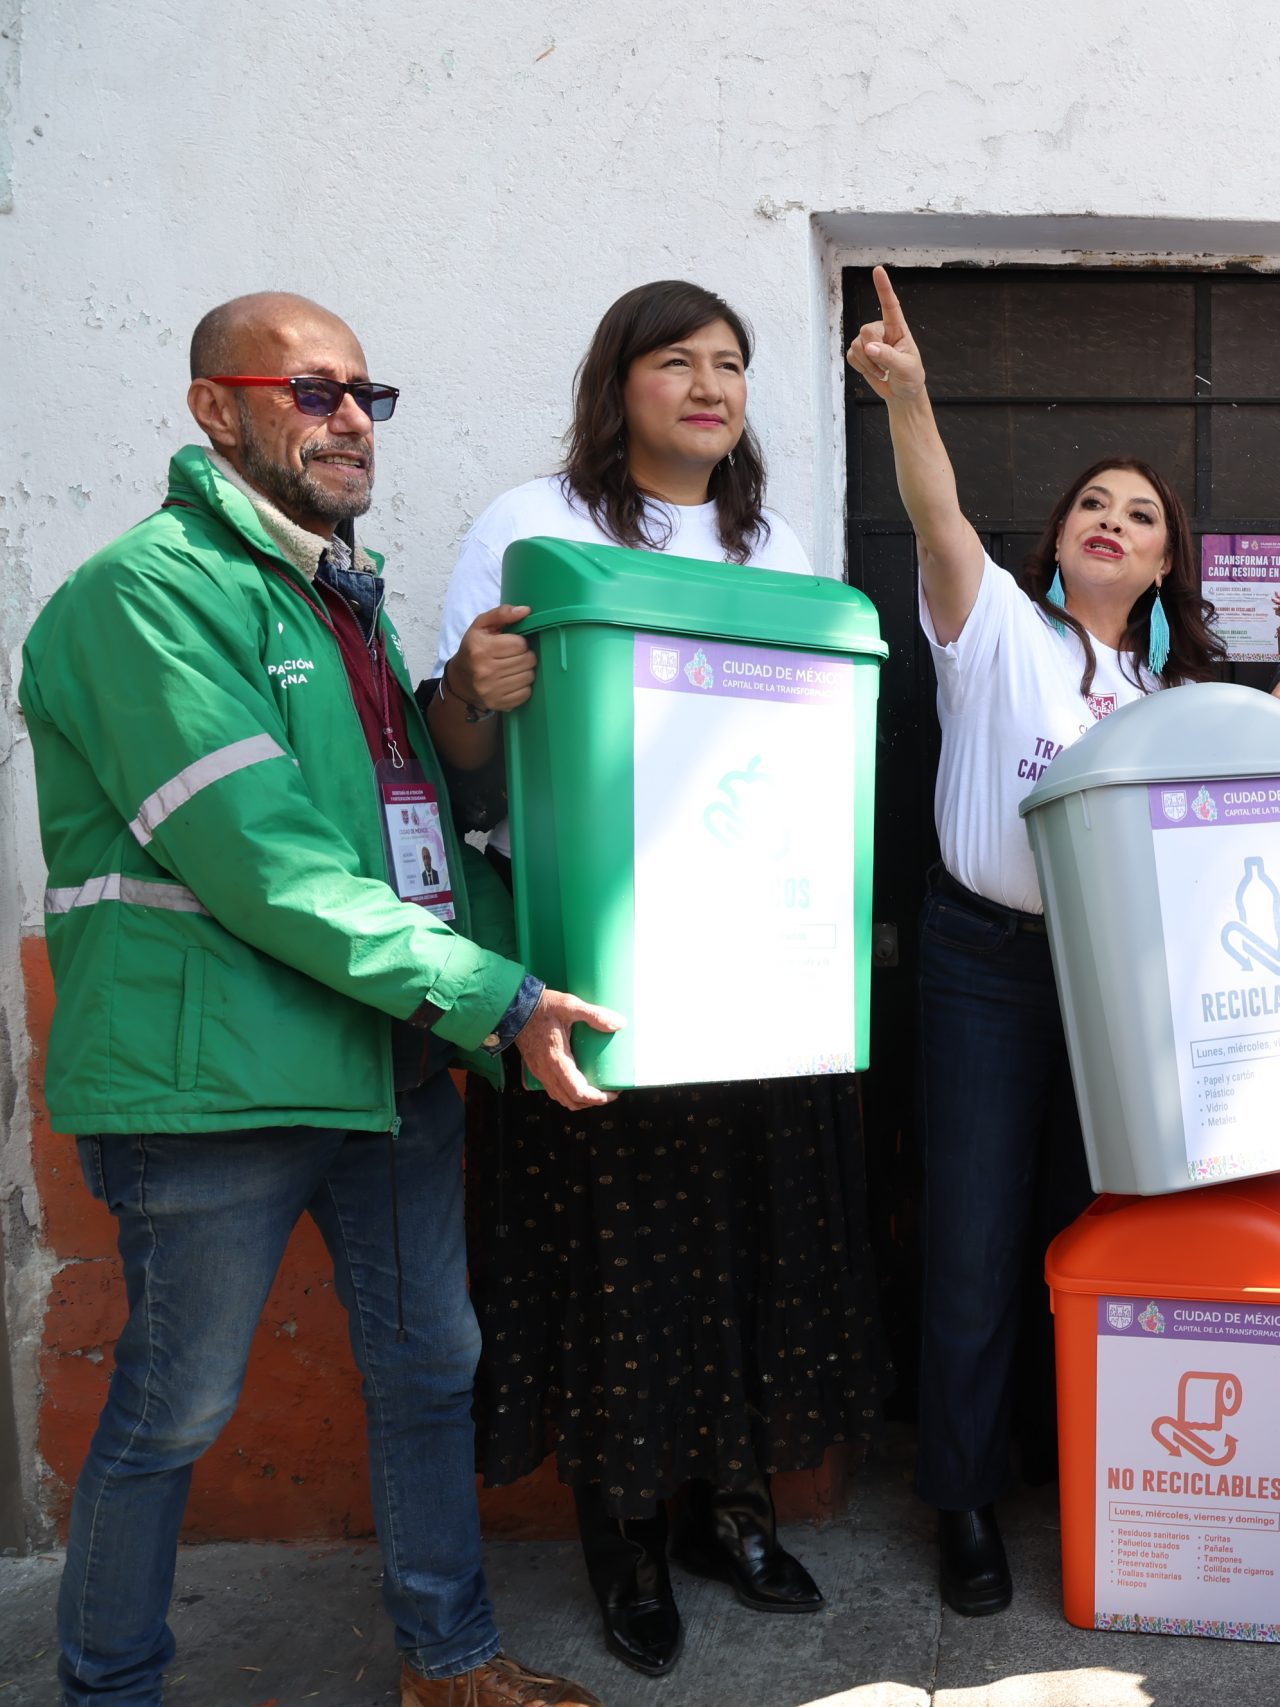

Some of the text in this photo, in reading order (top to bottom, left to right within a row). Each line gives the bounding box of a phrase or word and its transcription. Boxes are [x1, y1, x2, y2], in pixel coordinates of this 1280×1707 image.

[1214, 555, 1268, 566] TRANSFORMA
[1271, 556, 1280, 566] TU
[1209, 567, 1229, 577] CADA
[1232, 567, 1267, 577] RESIDUO
[1269, 568, 1279, 577] EN
[723, 660, 773, 678] CIUDAD
[776, 669, 792, 680] DE
[723, 680, 752, 690] CAPITAL
[754, 682, 765, 691] DE
[766, 683, 775, 692] LA
[1224, 792, 1265, 804] CIUDAD
[1197, 1047, 1226, 1058] Lunes,
[1228, 1039, 1271, 1055] miércoles,
[1204, 1074, 1224, 1086] Papel
[1226, 1074, 1230, 1084] y
[1205, 1088, 1235, 1100] Plástico
[1207, 1103, 1228, 1113] Vidrio
[1208, 1115, 1236, 1126] Metales
[1174, 1310, 1221, 1322] CIUDAD
[1224, 1313, 1241, 1323] DE
[1108, 1467, 1134, 1490] NO
[1115, 1508, 1275, 1526] Lunes, miércoles, viernes y domingo
[1118, 1528, 1190, 1541] Residuos sanitarios
[1205, 1534, 1231, 1543] Curitas
[1118, 1539, 1180, 1550] Pañuelos usados
[1204, 1545, 1233, 1553] Pañales
[1118, 1549, 1138, 1558] Papel
[1151, 1551, 1169, 1560] baño
[1204, 1555, 1242, 1565] Tampones
[1118, 1559, 1167, 1569] Preservativos
[1118, 1569, 1182, 1580] Toallas sanitarias
[1204, 1565, 1230, 1574] Colillas
[1244, 1568, 1274, 1577] cigarros
[1118, 1579, 1147, 1588] Hisopos
[1203, 1575, 1231, 1583] Chicles
